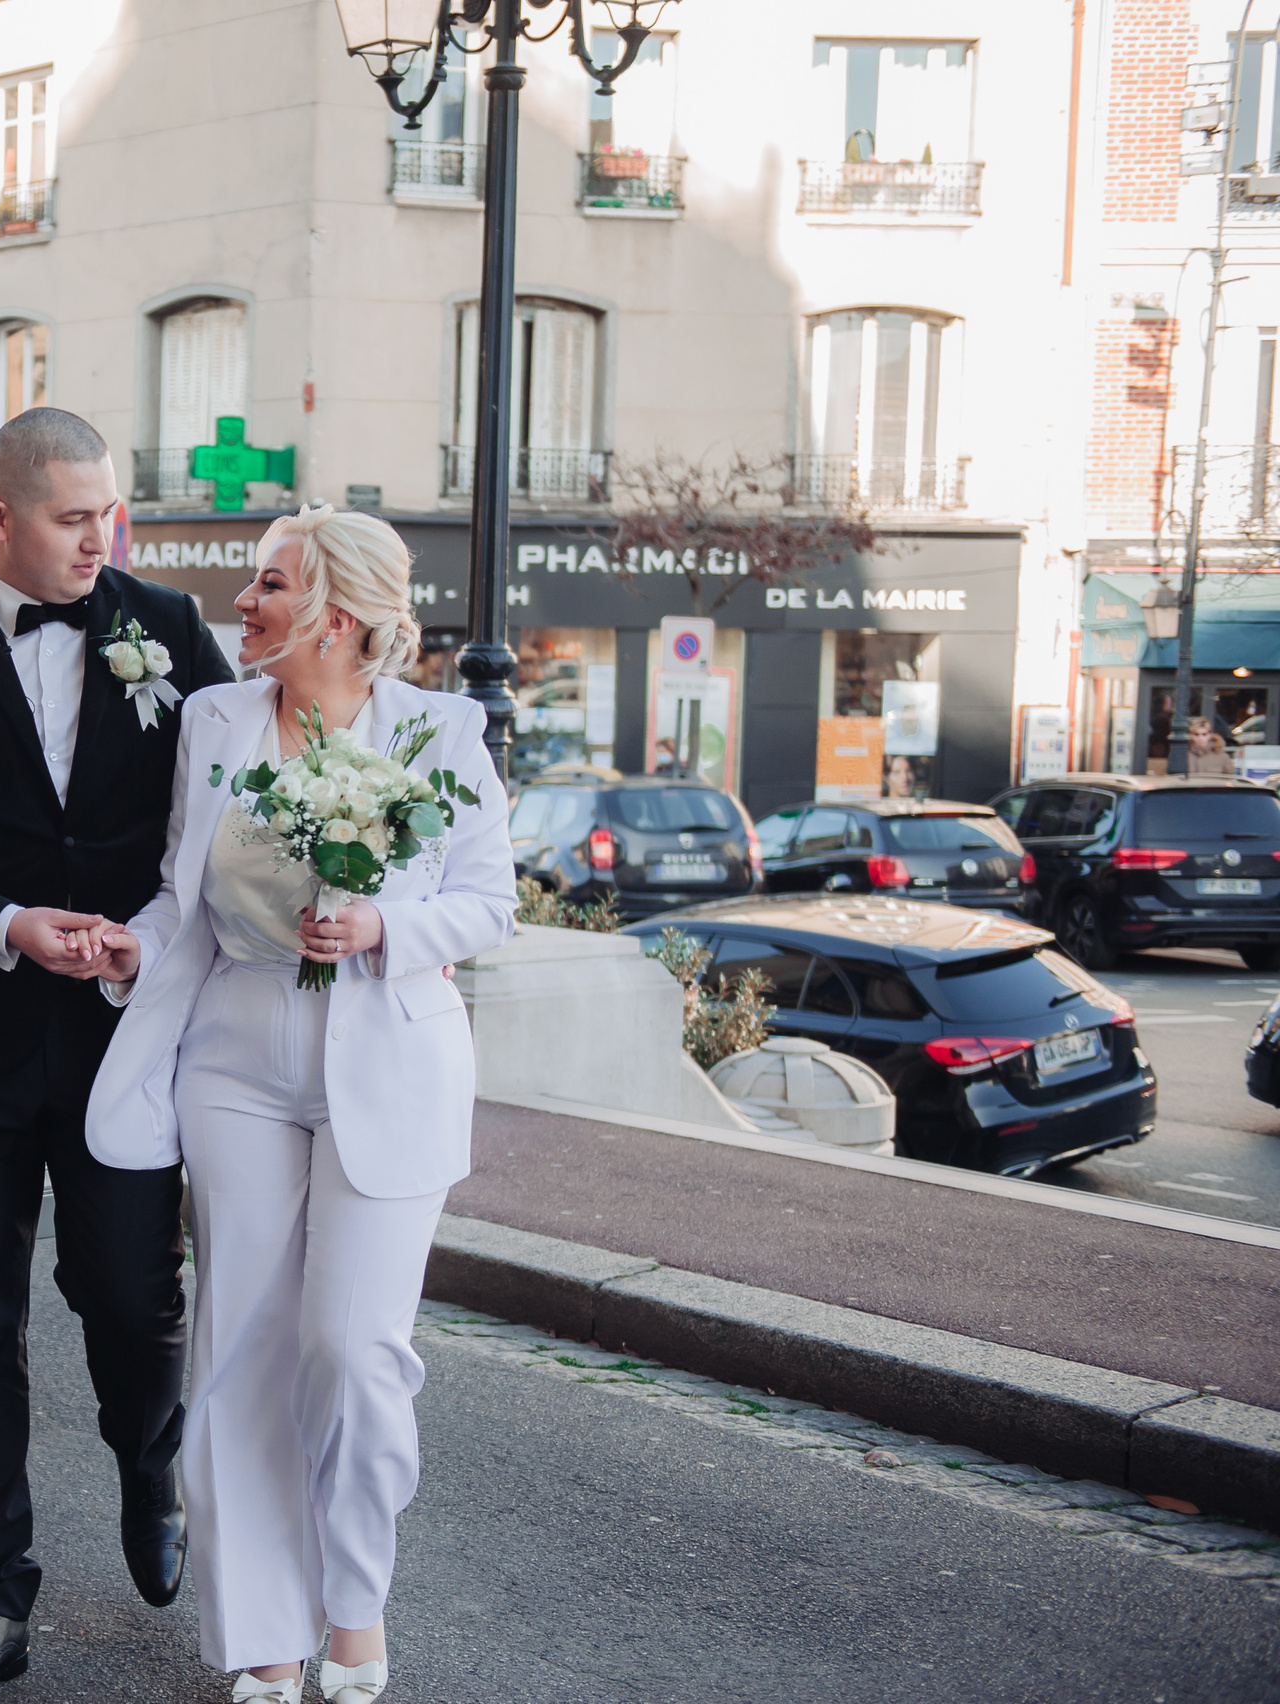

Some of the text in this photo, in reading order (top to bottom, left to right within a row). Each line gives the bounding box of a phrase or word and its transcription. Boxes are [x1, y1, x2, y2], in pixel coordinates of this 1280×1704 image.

[128, 541, 255, 568] HARMACI
[517, 544, 777, 575] PHARMACI
[765, 587, 968, 611] DE LA MAIRIE
